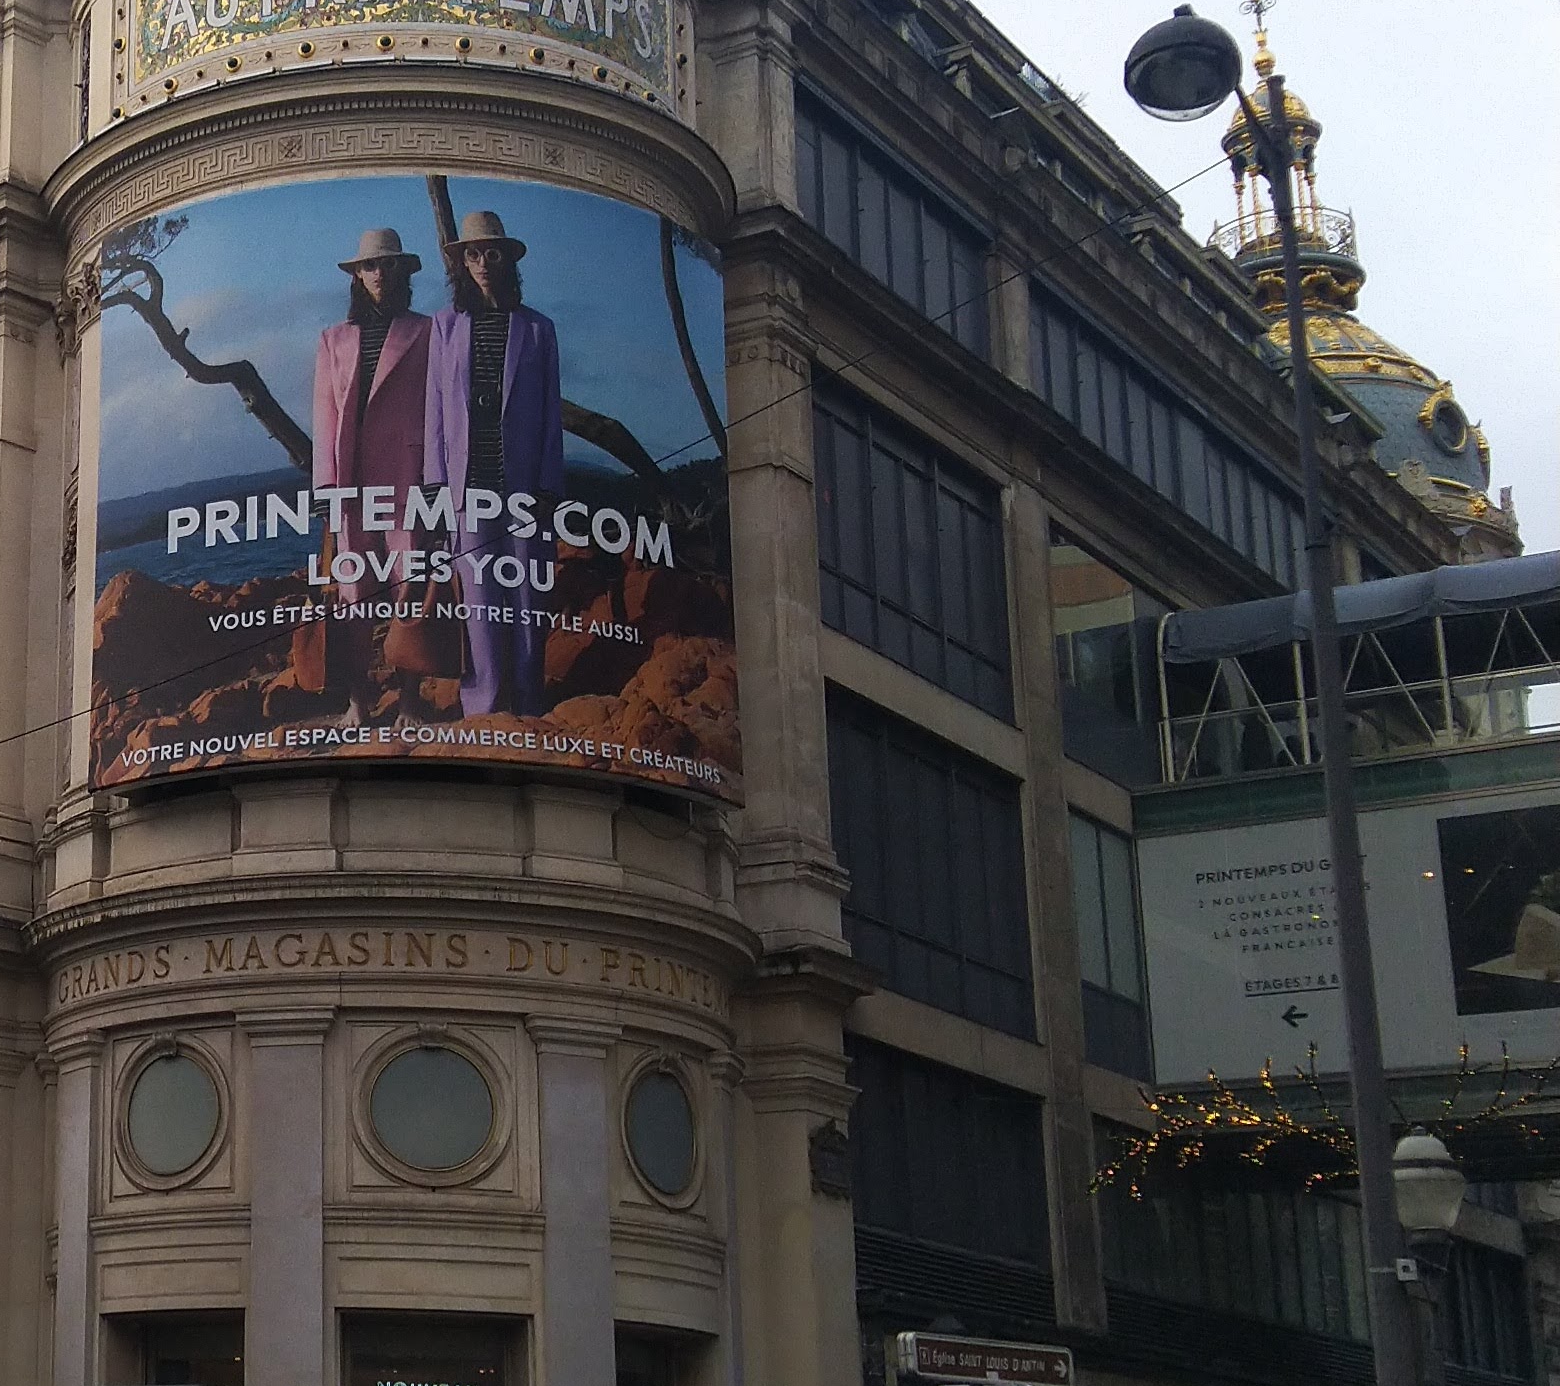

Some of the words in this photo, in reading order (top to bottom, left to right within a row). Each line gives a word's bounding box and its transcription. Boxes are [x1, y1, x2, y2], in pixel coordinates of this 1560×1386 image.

[167, 485, 675, 568] PRINTEMPS.COM
[308, 550, 453, 586] LOVES
[458, 552, 555, 592] YOU
[208, 610, 266, 632] VOUS
[272, 604, 326, 625] ÊTES
[333, 602, 429, 620] UNIQUE.
[436, 602, 514, 624] NOTRE
[520, 609, 583, 633] STYLE
[588, 619, 644, 645] AUSSI.
[121, 742, 184, 768] VOTRE
[189, 732, 279, 757] NOUVEL
[285, 726, 371, 747] ESPACE
[378, 726, 537, 750] E-COMMERCE
[543, 734, 595, 756] LUXE
[601, 742, 625, 760] ET
[630, 747, 721, 784] CRÉATEURS
[1196, 862, 1287, 884] PRINTEMPS
[1291, 860, 1314, 874] DU
[58, 944, 171, 1004] GRANDS
[202, 931, 467, 973] MAGASINS
[506, 937, 569, 976] DU
[959, 1353, 981, 1367] SAINT
[986, 1357, 1008, 1370] LOUIS
